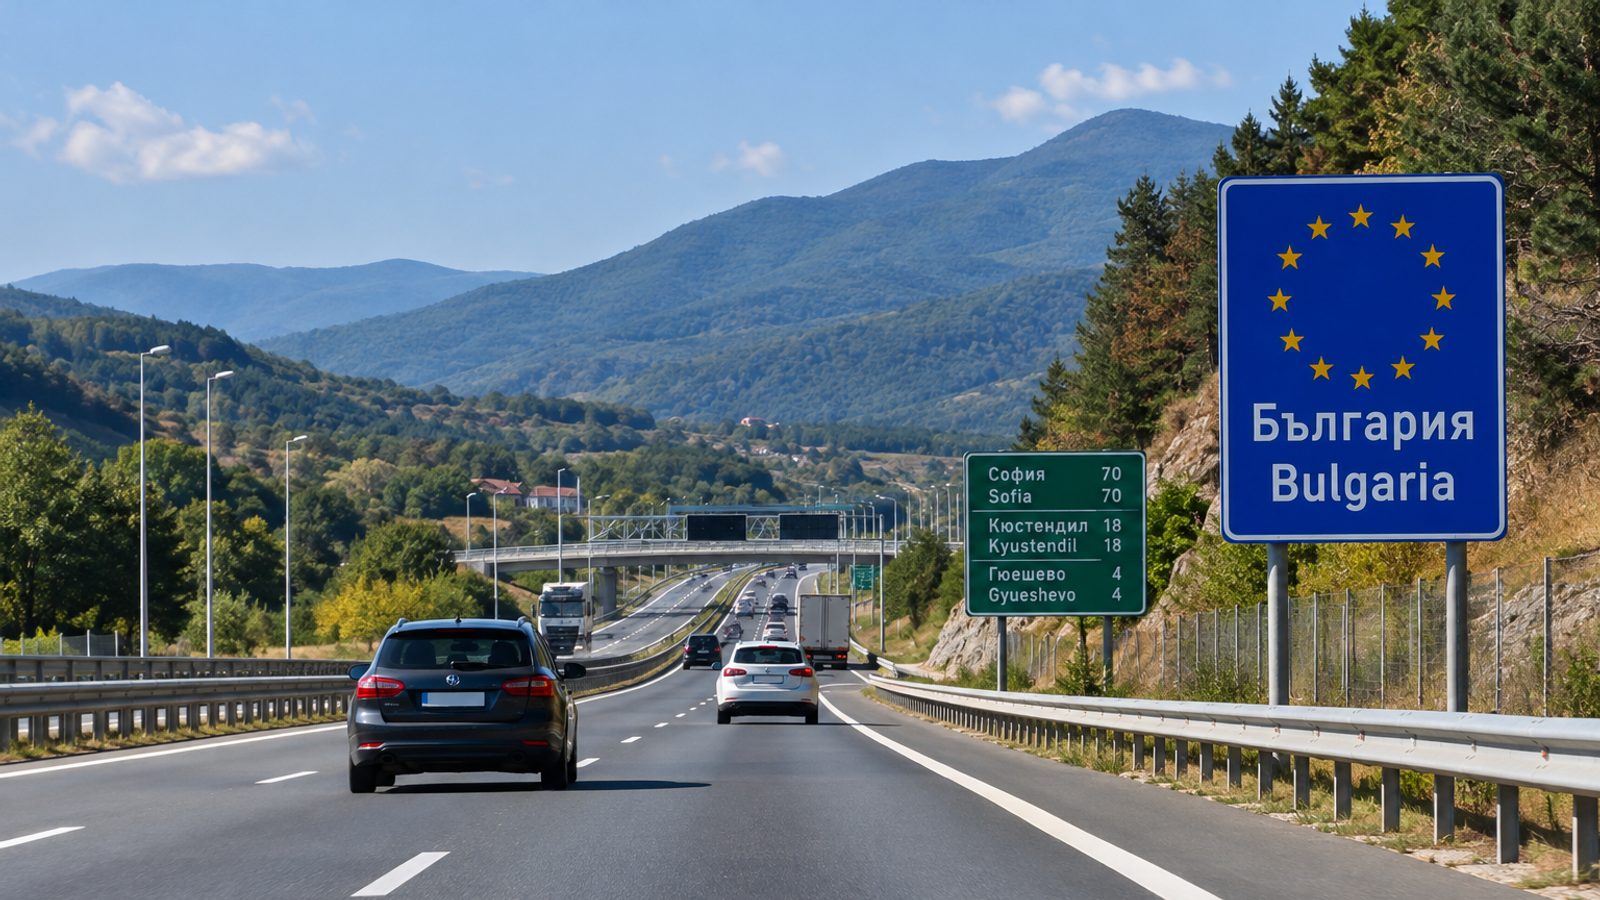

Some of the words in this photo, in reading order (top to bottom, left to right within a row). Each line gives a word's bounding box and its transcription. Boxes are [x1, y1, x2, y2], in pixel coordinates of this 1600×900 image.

[1253, 402, 1474, 451] България
[988, 466, 1045, 485] София
[1101, 466, 1122, 481] 70
[988, 488, 1032, 504] Sofia
[1101, 488, 1122, 503] 70
[1272, 461, 1455, 512] Bulgaria
[988, 518, 1088, 535] Кюстендил
[1103, 518, 1122, 532] 18
[988, 537, 1077, 557] Kyustendil
[1104, 538, 1122, 553] 18
[988, 566, 1066, 582] Гюешево
[1111, 566, 1122, 581] 4
[988, 587, 1076, 606] Gyueshevo
[1111, 587, 1122, 601] 4
